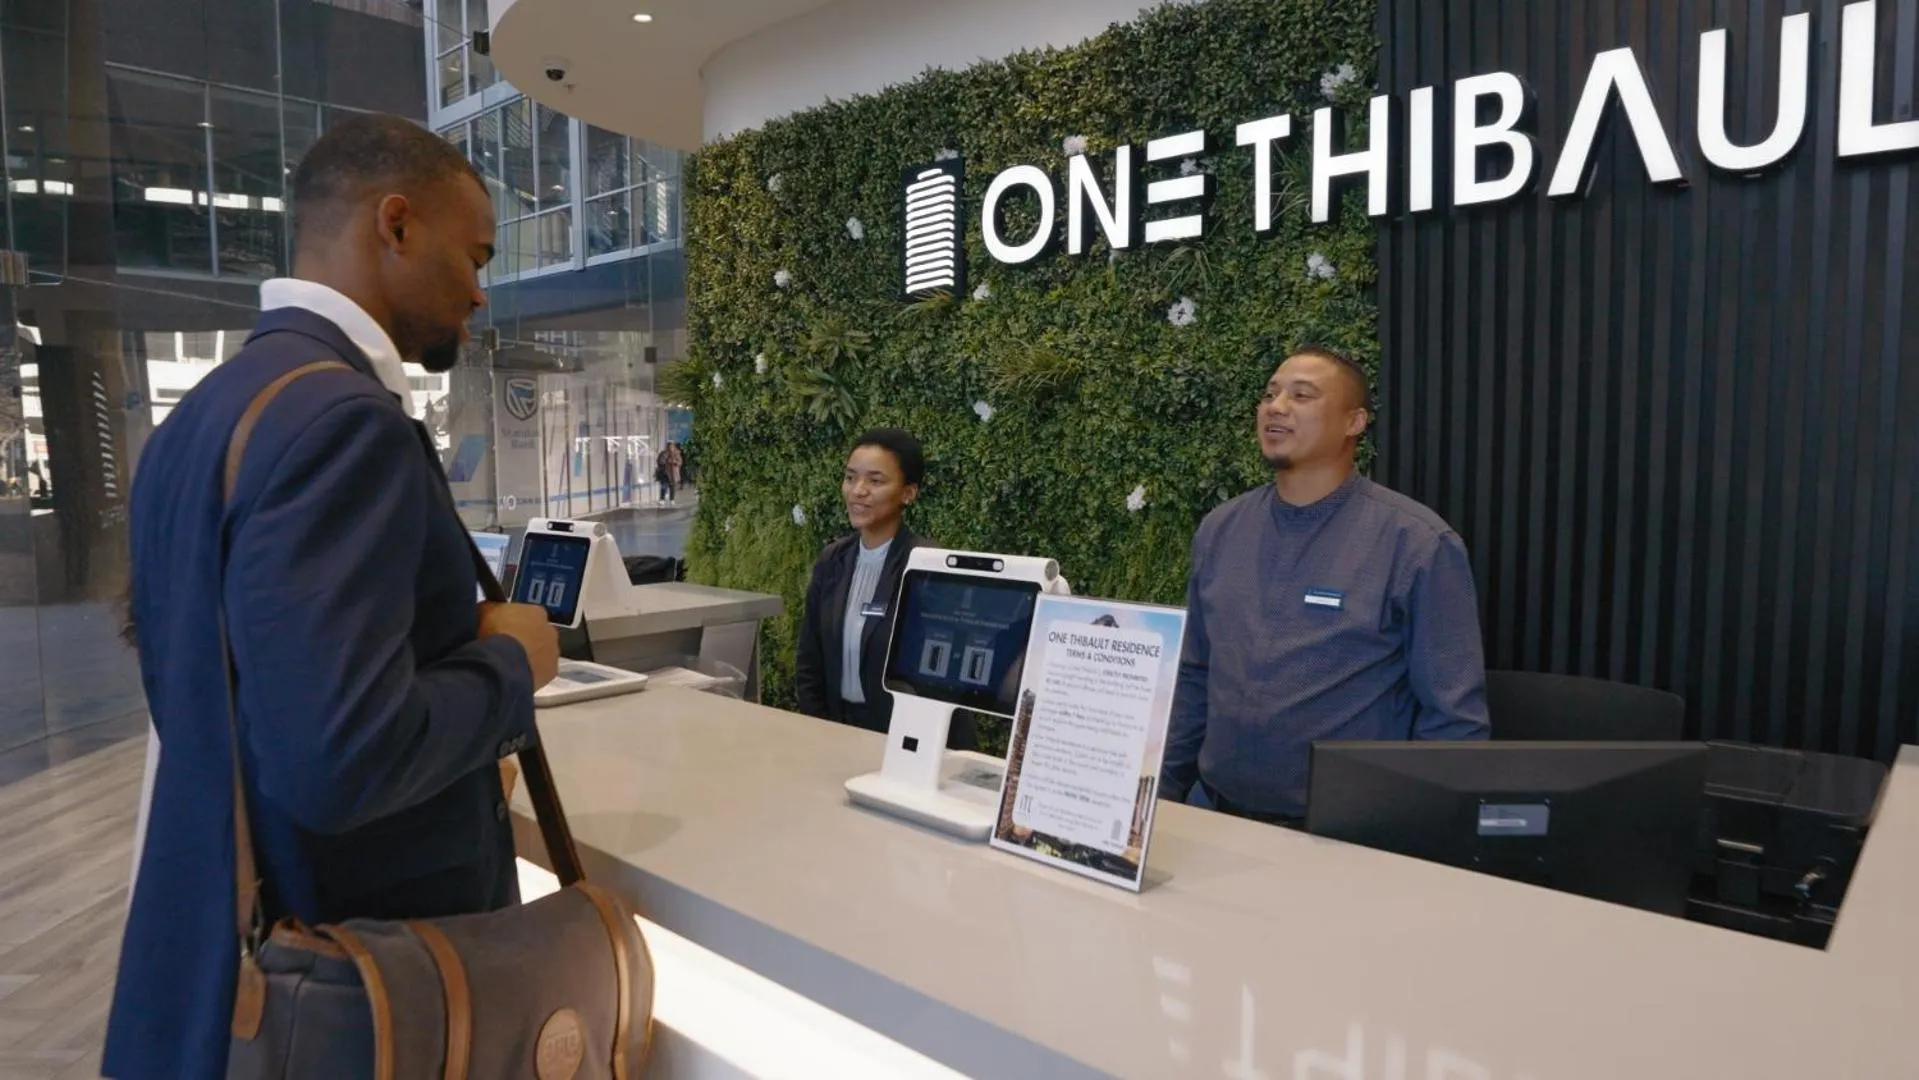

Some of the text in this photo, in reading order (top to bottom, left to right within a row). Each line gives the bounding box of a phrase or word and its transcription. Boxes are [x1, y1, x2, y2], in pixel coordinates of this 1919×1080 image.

[982, 130, 1204, 264] ONE
[1048, 632, 1160, 658] ONE THIBAULT RESIDENCE
